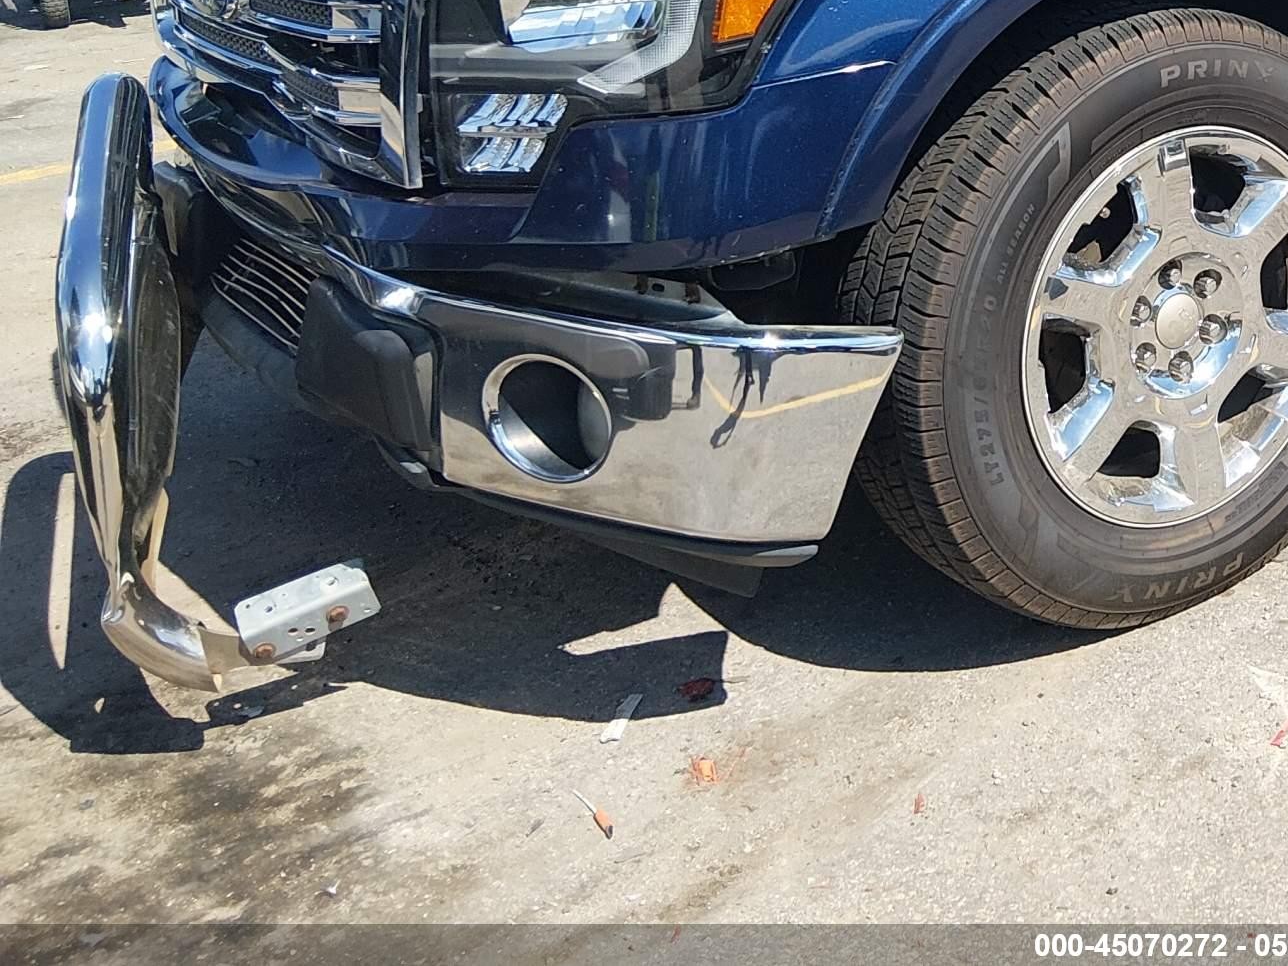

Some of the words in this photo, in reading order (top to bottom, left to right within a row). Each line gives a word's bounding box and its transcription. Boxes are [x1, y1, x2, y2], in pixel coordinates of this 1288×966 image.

[1160, 58, 1277, 88] PRINX
[1006, 203, 1036, 259] SEASON
[1104, 552, 1244, 604] PRINX
